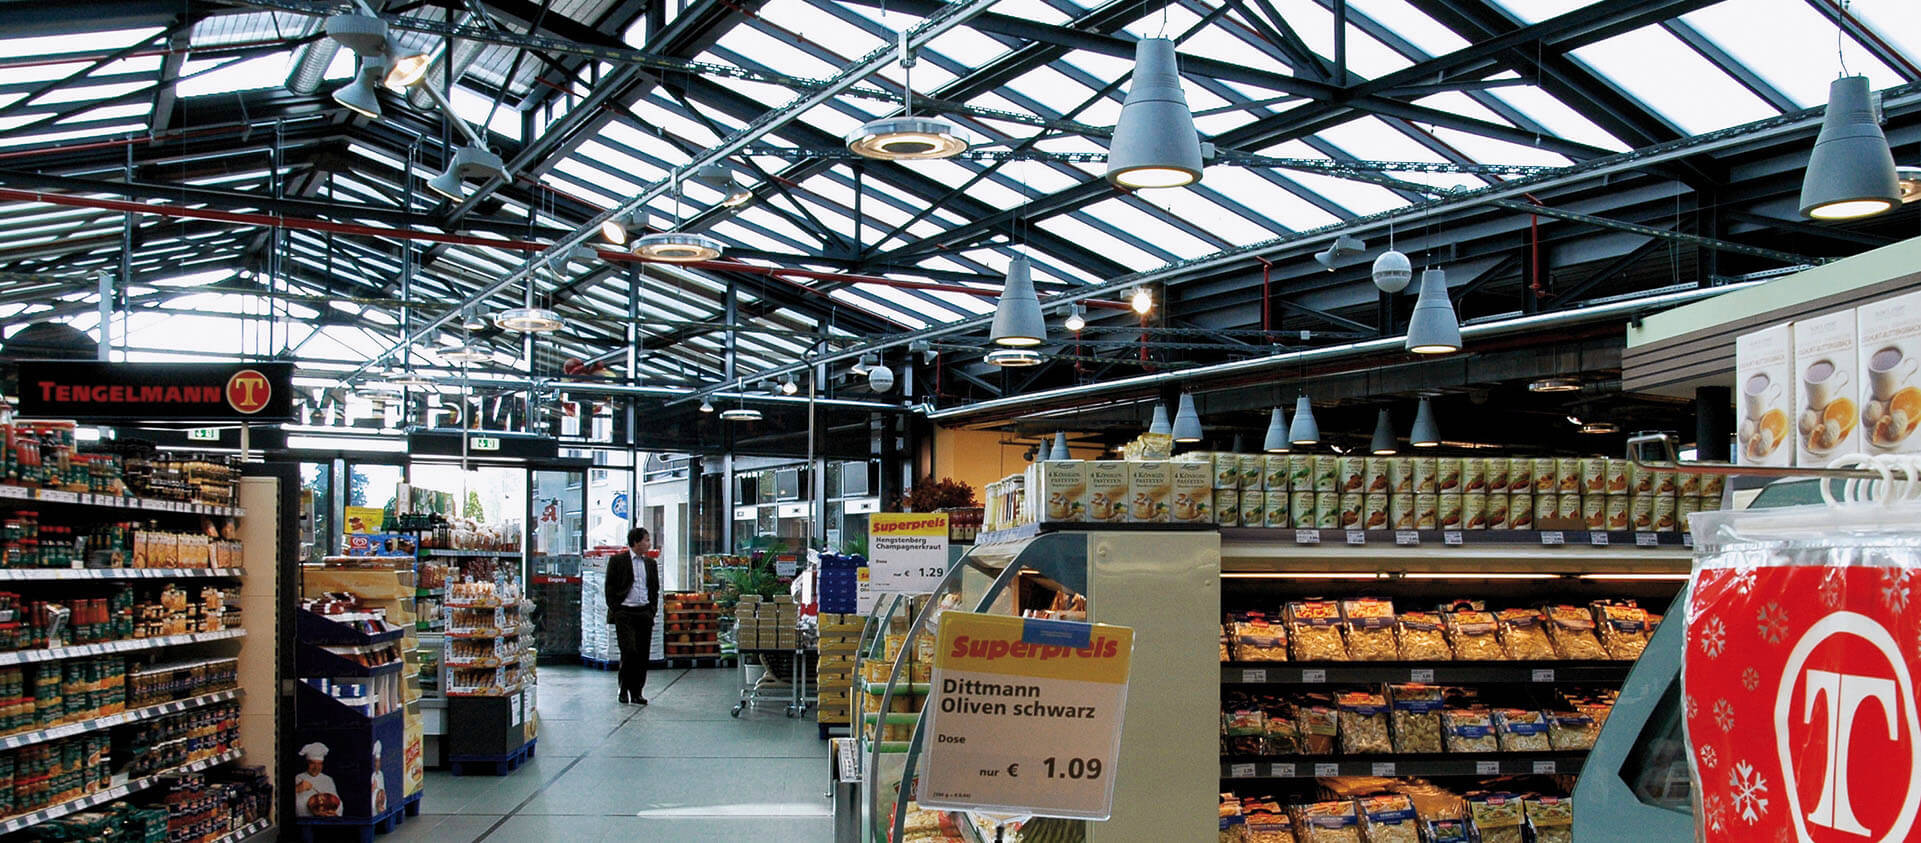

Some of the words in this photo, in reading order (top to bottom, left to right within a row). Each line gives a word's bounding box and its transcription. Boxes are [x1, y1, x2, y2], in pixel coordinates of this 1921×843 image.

[38, 381, 221, 402] TENGELMANN
[873, 517, 945, 533] Superpreis
[919, 568, 944, 577] 1.29
[943, 679, 1040, 698] Dittmann
[941, 698, 1006, 715] Oliven
[1013, 701, 1096, 719] schwarz
[938, 734, 966, 744] Dose
[980, 768, 999, 776] nur
[1006, 764, 1019, 777] €
[1043, 757, 1102, 780] 1.09
